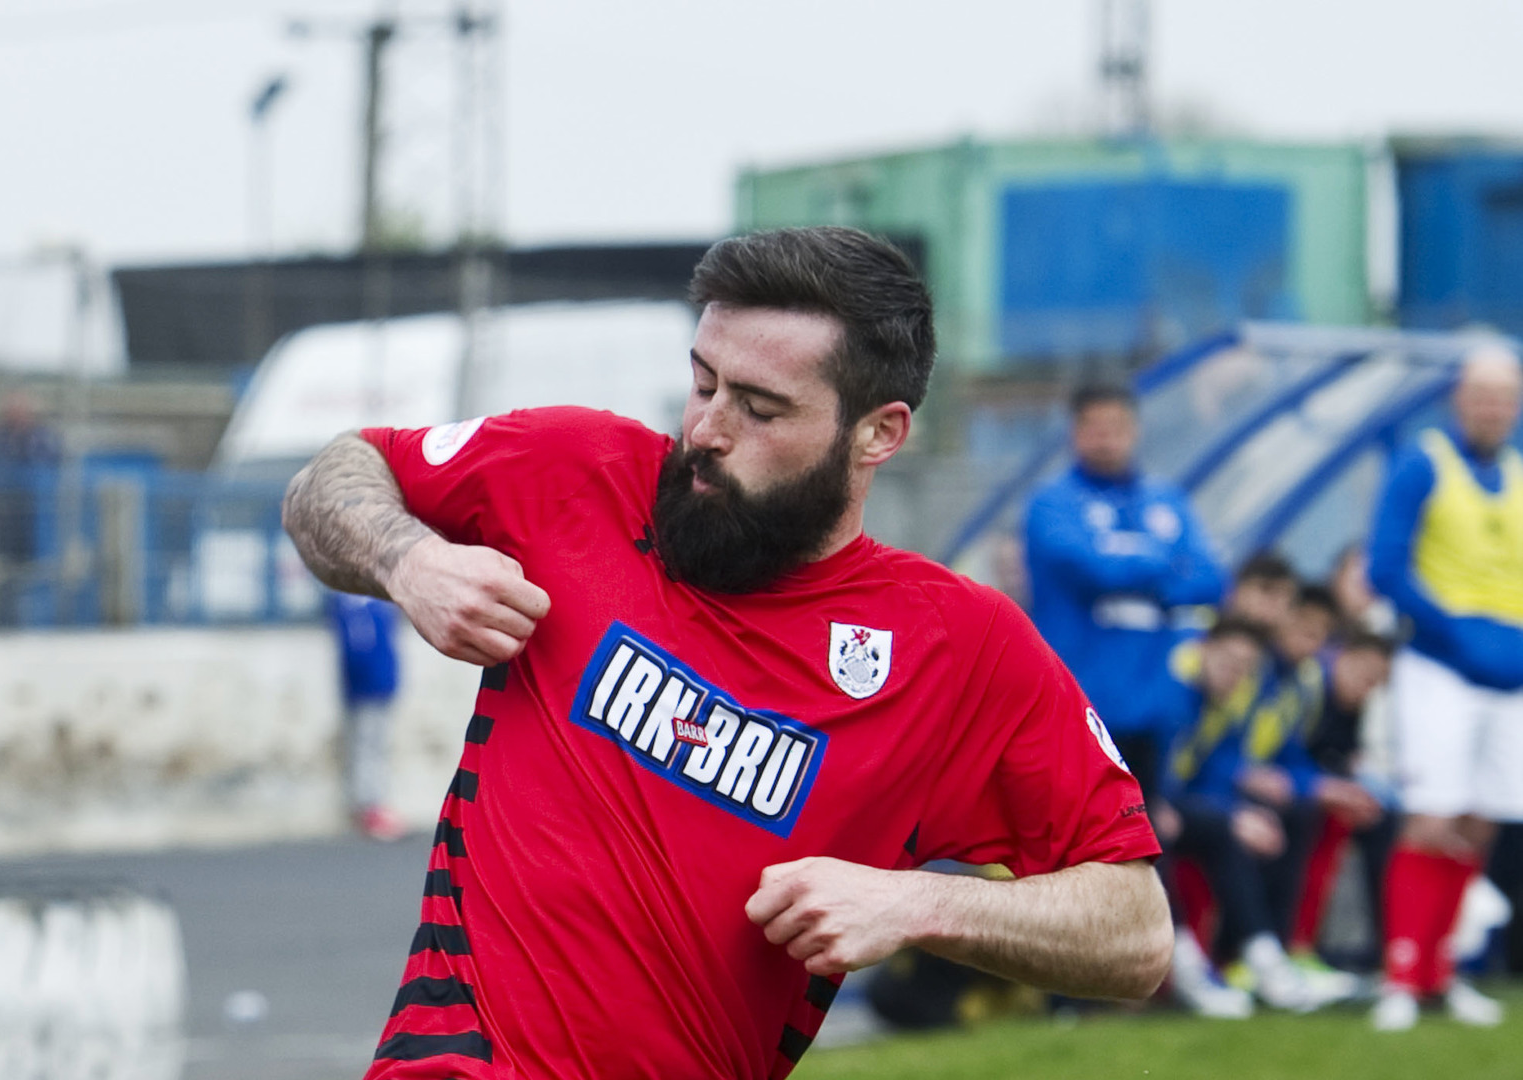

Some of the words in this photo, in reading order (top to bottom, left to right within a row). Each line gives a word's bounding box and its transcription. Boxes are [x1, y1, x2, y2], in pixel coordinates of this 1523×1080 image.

[588, 643, 698, 762] IRN
[682, 704, 807, 816] BRU
[676, 719, 708, 743] BARR
